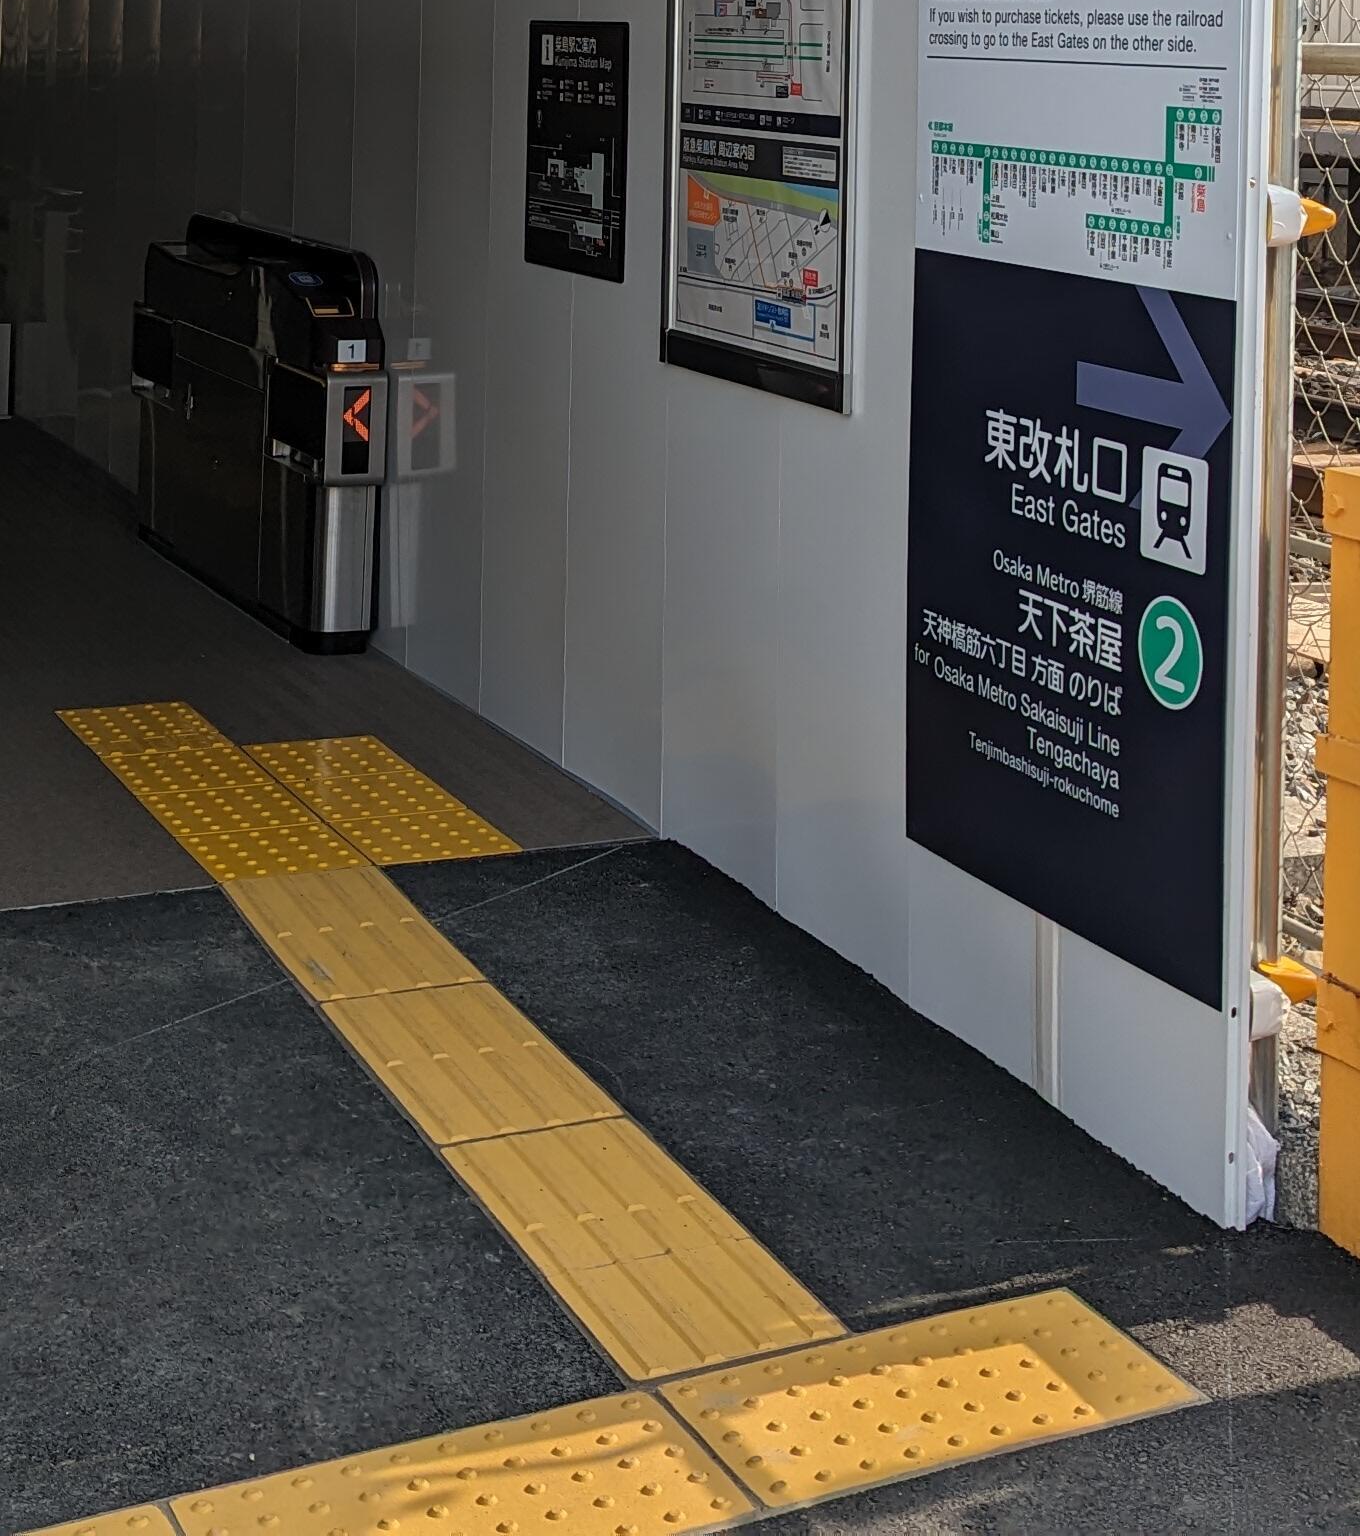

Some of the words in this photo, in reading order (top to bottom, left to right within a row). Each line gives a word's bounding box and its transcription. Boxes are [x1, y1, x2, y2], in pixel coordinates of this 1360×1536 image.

[928, 31, 969, 49] crossing
[971, 32, 982, 46] to
[983, 36, 997, 50] go
[998, 32, 1010, 47] to
[1011, 31, 1029, 47] the
[1031, 32, 1055, 49] East
[1057, 32, 1090, 49] Gates
[1092, 38, 1108, 50] on
[1110, 33, 1130, 51] the
[1131, 33, 1165, 52] other
[1167, 34, 1198, 53] side.
[929, 7, 937, 23] If
[938, 12, 956, 27] you
[958, 8, 980, 24] wish
[982, 10, 992, 24] to
[994, 9, 1041, 29] purchase
[1044, 8, 1084, 28] tickets,
[1087, 8, 1125, 31] please
[1127, 13, 1149, 27] use
[1152, 10, 1172, 27] the
[1175, 10, 1224, 28] railroad
[347, 343, 355, 359] 1
[984, 408, 1128, 504] 東改札口
[1011, 482, 1055, 526] East
[1062, 499, 1126, 549] Gates
[993, 549, 1033, 582] Osaka
[1036, 564, 1080, 598] Metro
[1081, 578, 1124, 615] 堺筋線
[922, 608, 1026, 677] 天神橋筋六丁目
[1031, 655, 1065, 694] 方面
[1069, 671, 1123, 716] のりば
[1018, 587, 1123, 673] 天下茶屋
[1154, 615, 1186, 694] 2
[914, 642, 931, 665] for
[934, 656, 975, 693] Osaka
[977, 673, 1018, 711] Metro
[1020, 693, 1084, 744] Sakaisuji
[1088, 721, 1120, 757] Line
[968, 730, 1120, 819] Tenjimbashisuji-rokuchome
[1026, 725, 1120, 790] Tengachaya
